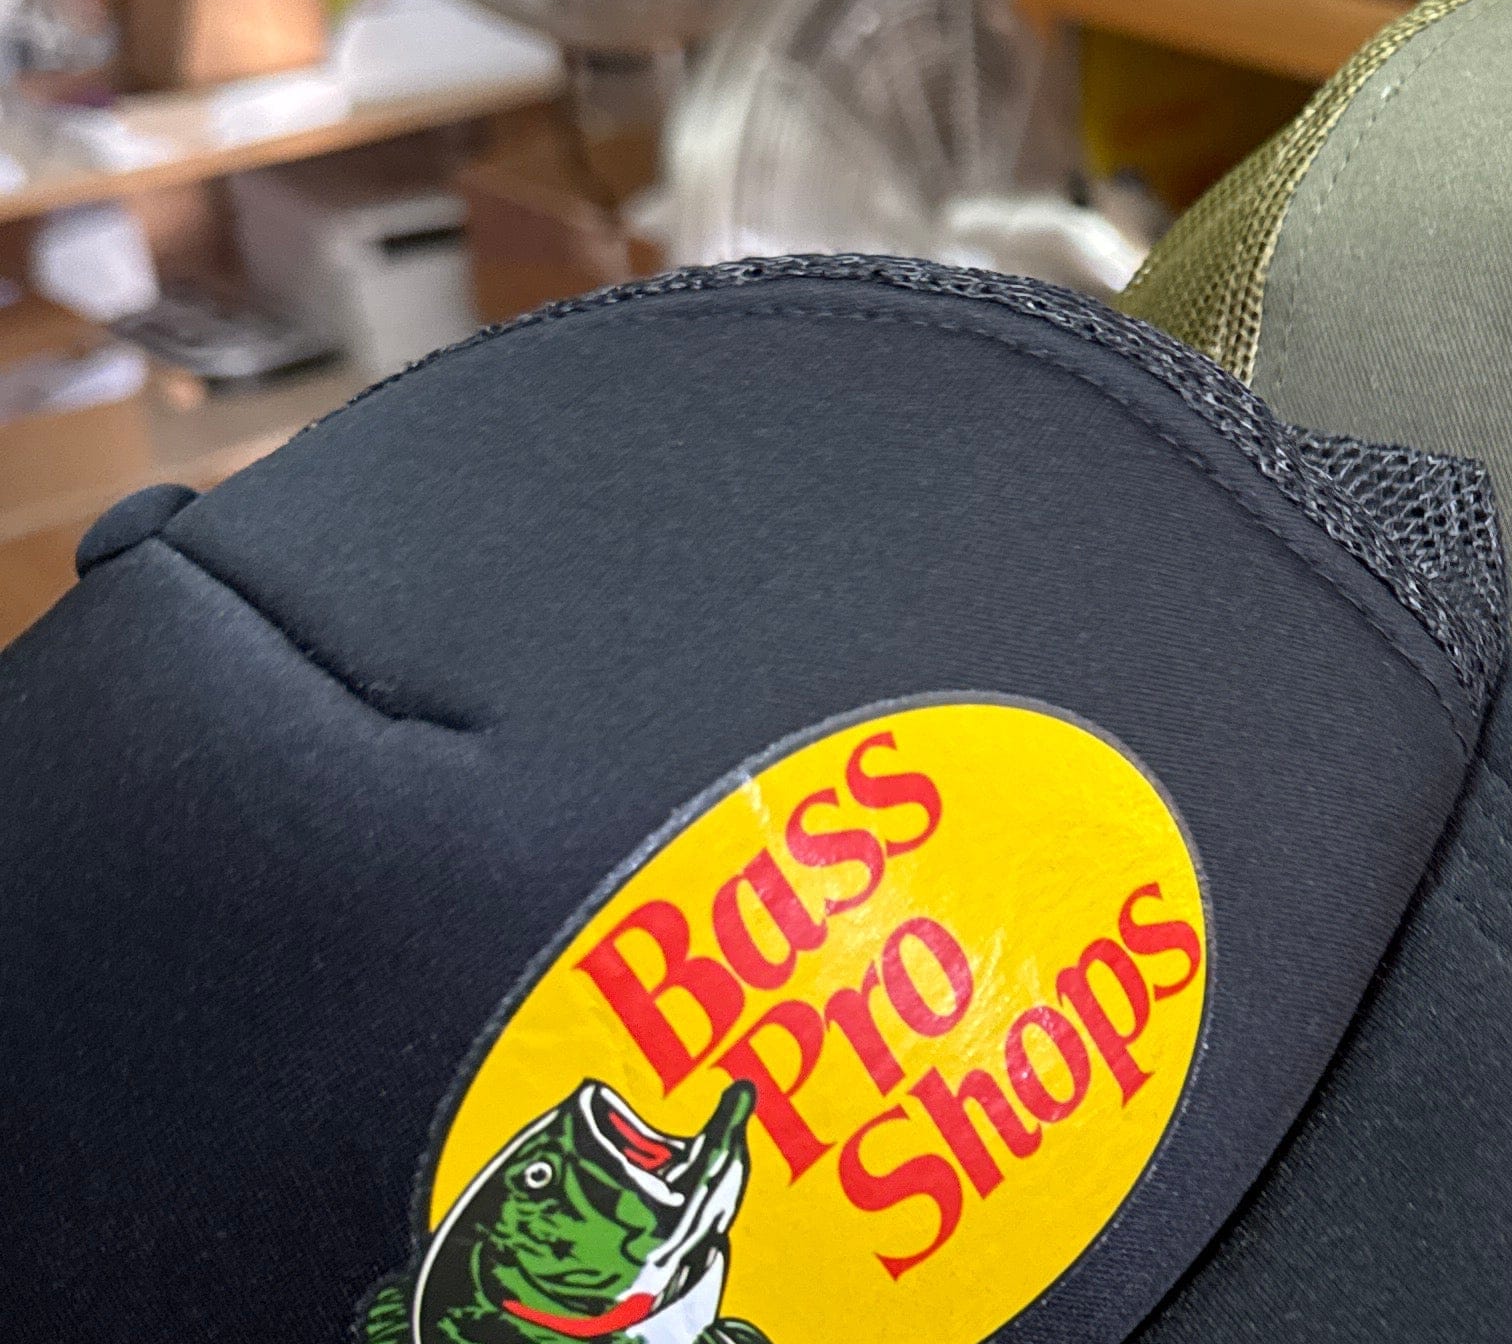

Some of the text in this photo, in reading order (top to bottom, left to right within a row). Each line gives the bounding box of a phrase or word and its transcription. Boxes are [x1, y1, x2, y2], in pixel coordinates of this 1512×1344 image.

[576, 730, 942, 1098] Bass
[708, 916, 974, 1188] Pro
[838, 882, 1200, 1280] Shops
